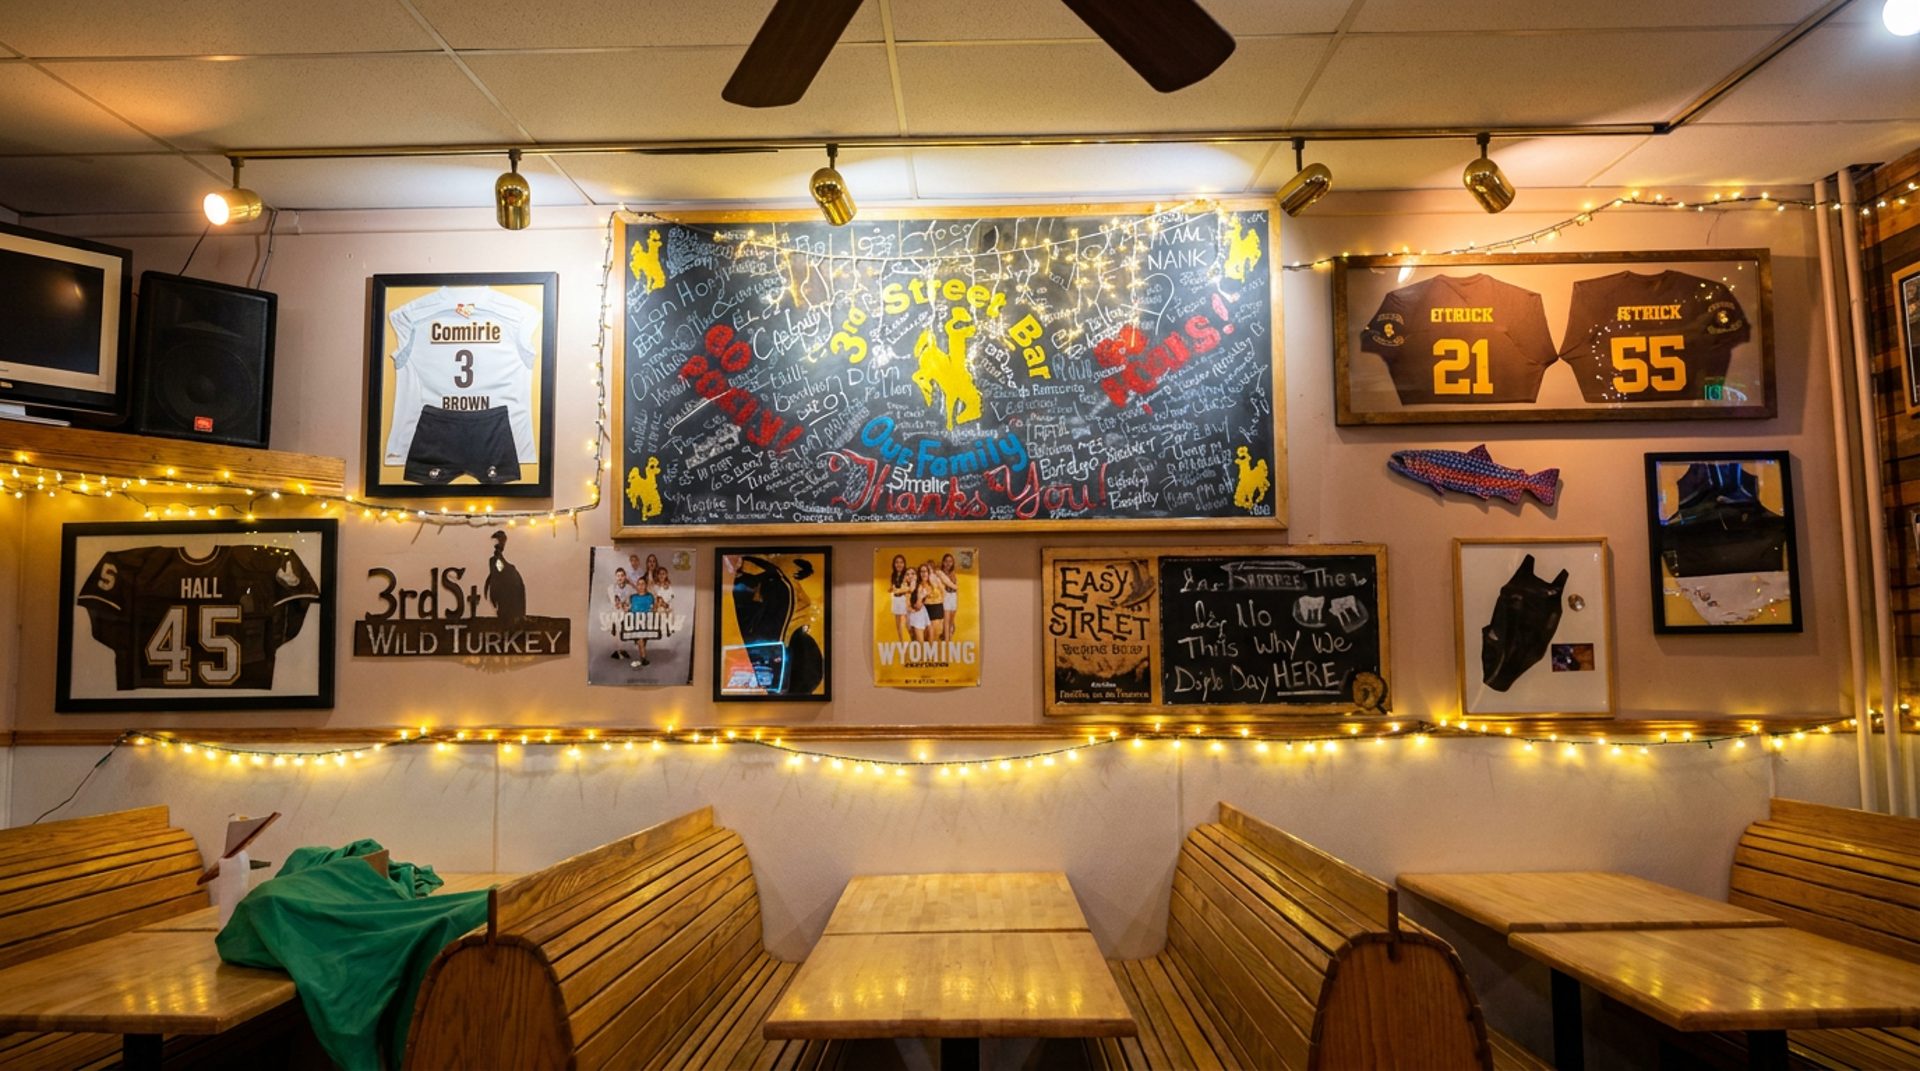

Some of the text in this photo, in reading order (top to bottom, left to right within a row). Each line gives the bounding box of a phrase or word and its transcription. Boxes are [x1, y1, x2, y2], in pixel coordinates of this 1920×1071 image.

[830, 307, 867, 364] 3rd
[883, 278, 1006, 318] Street
[1008, 314, 1051, 380] Bar
[454, 349, 474, 389] 3
[1432, 338, 1494, 395] 21
[1610, 335, 1687, 393] 55
[442, 396, 489, 410] BROWN
[917, 433, 1028, 478] Family
[181, 577, 222, 598] HALL
[1060, 564, 1128, 603] EASY
[1049, 603, 1150, 641] STREET
[145, 605, 242, 685] 45
[878, 641, 975, 665] WYOMING
[1253, 630, 1301, 660] Why
[1312, 632, 1352, 654] We
[1231, 664, 1269, 703] Day
[1273, 660, 1339, 688] HERE
